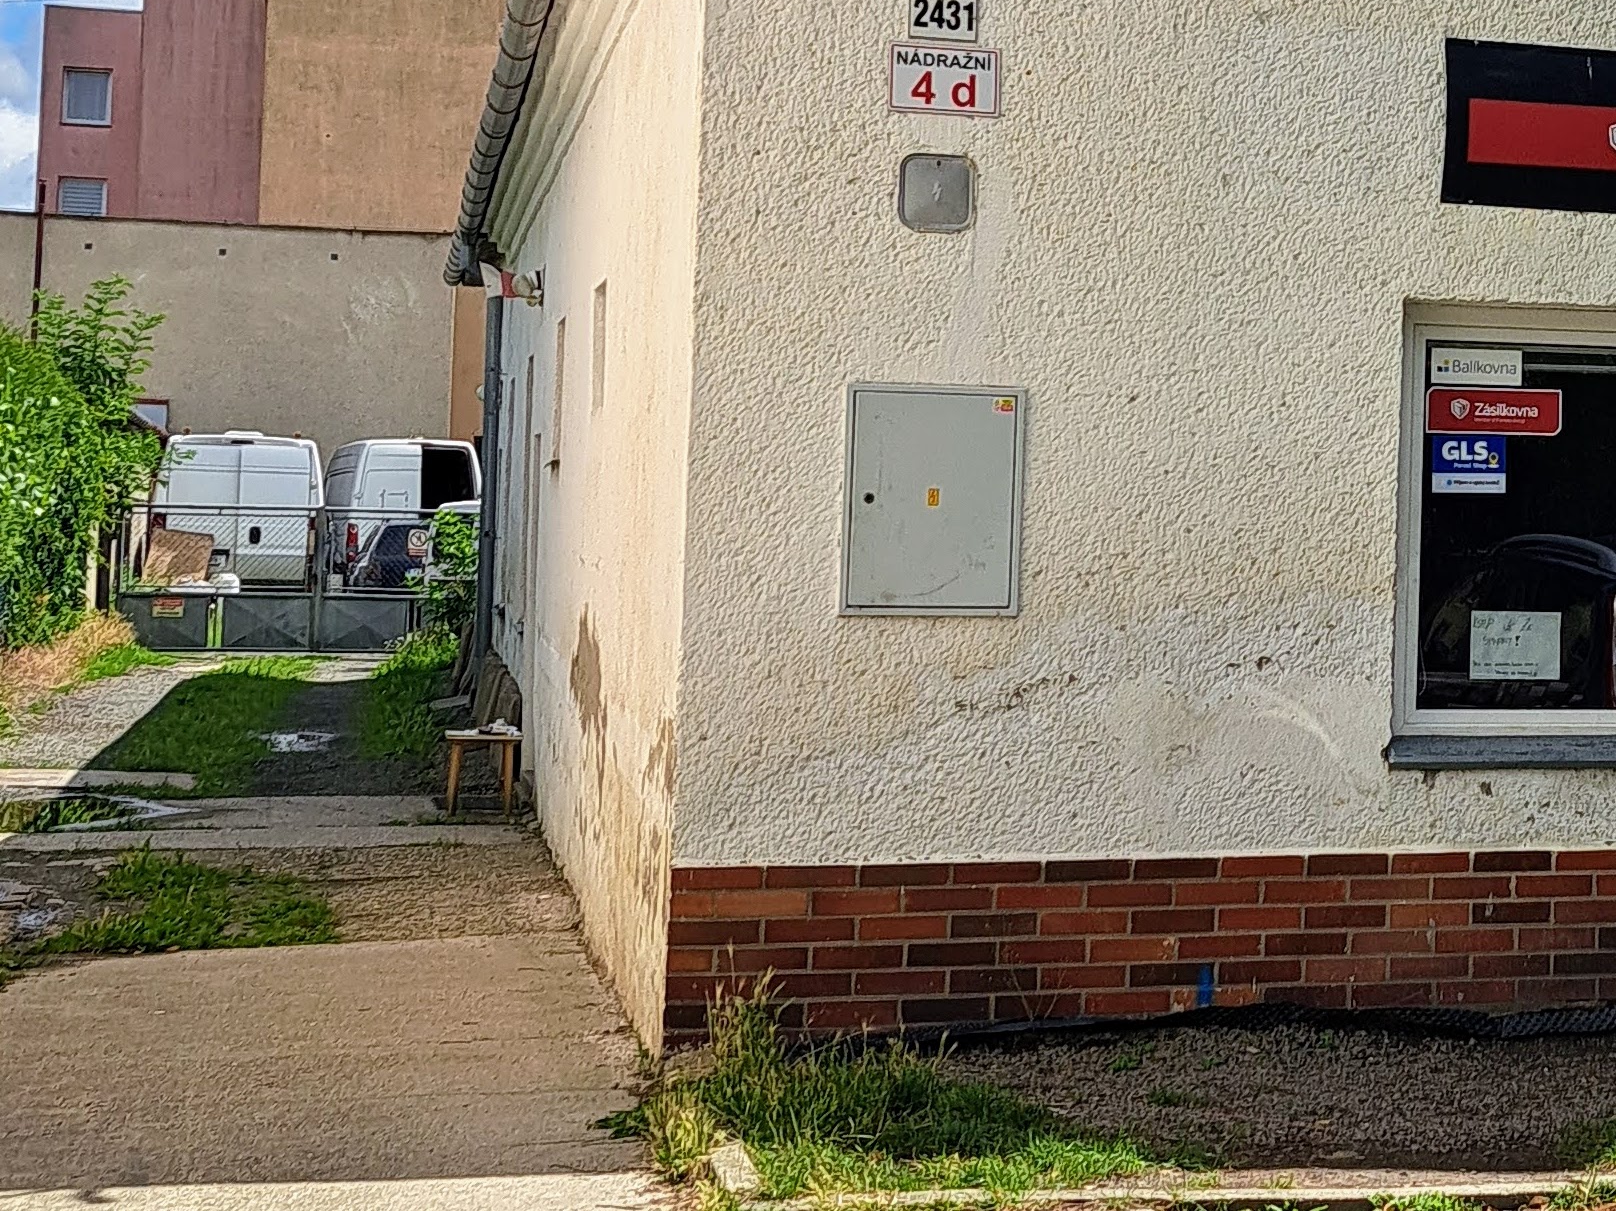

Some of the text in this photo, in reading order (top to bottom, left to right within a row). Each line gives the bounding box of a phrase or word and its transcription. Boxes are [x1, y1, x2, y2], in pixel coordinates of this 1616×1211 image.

[896, 49, 991, 71] NÁDRAŽNÍ
[911, 70, 976, 108] 4 d
[1452, 359, 1517, 375] Balíkovna
[1474, 402, 1539, 418] Zásilkovna
[1441, 440, 1489, 461] GLS
